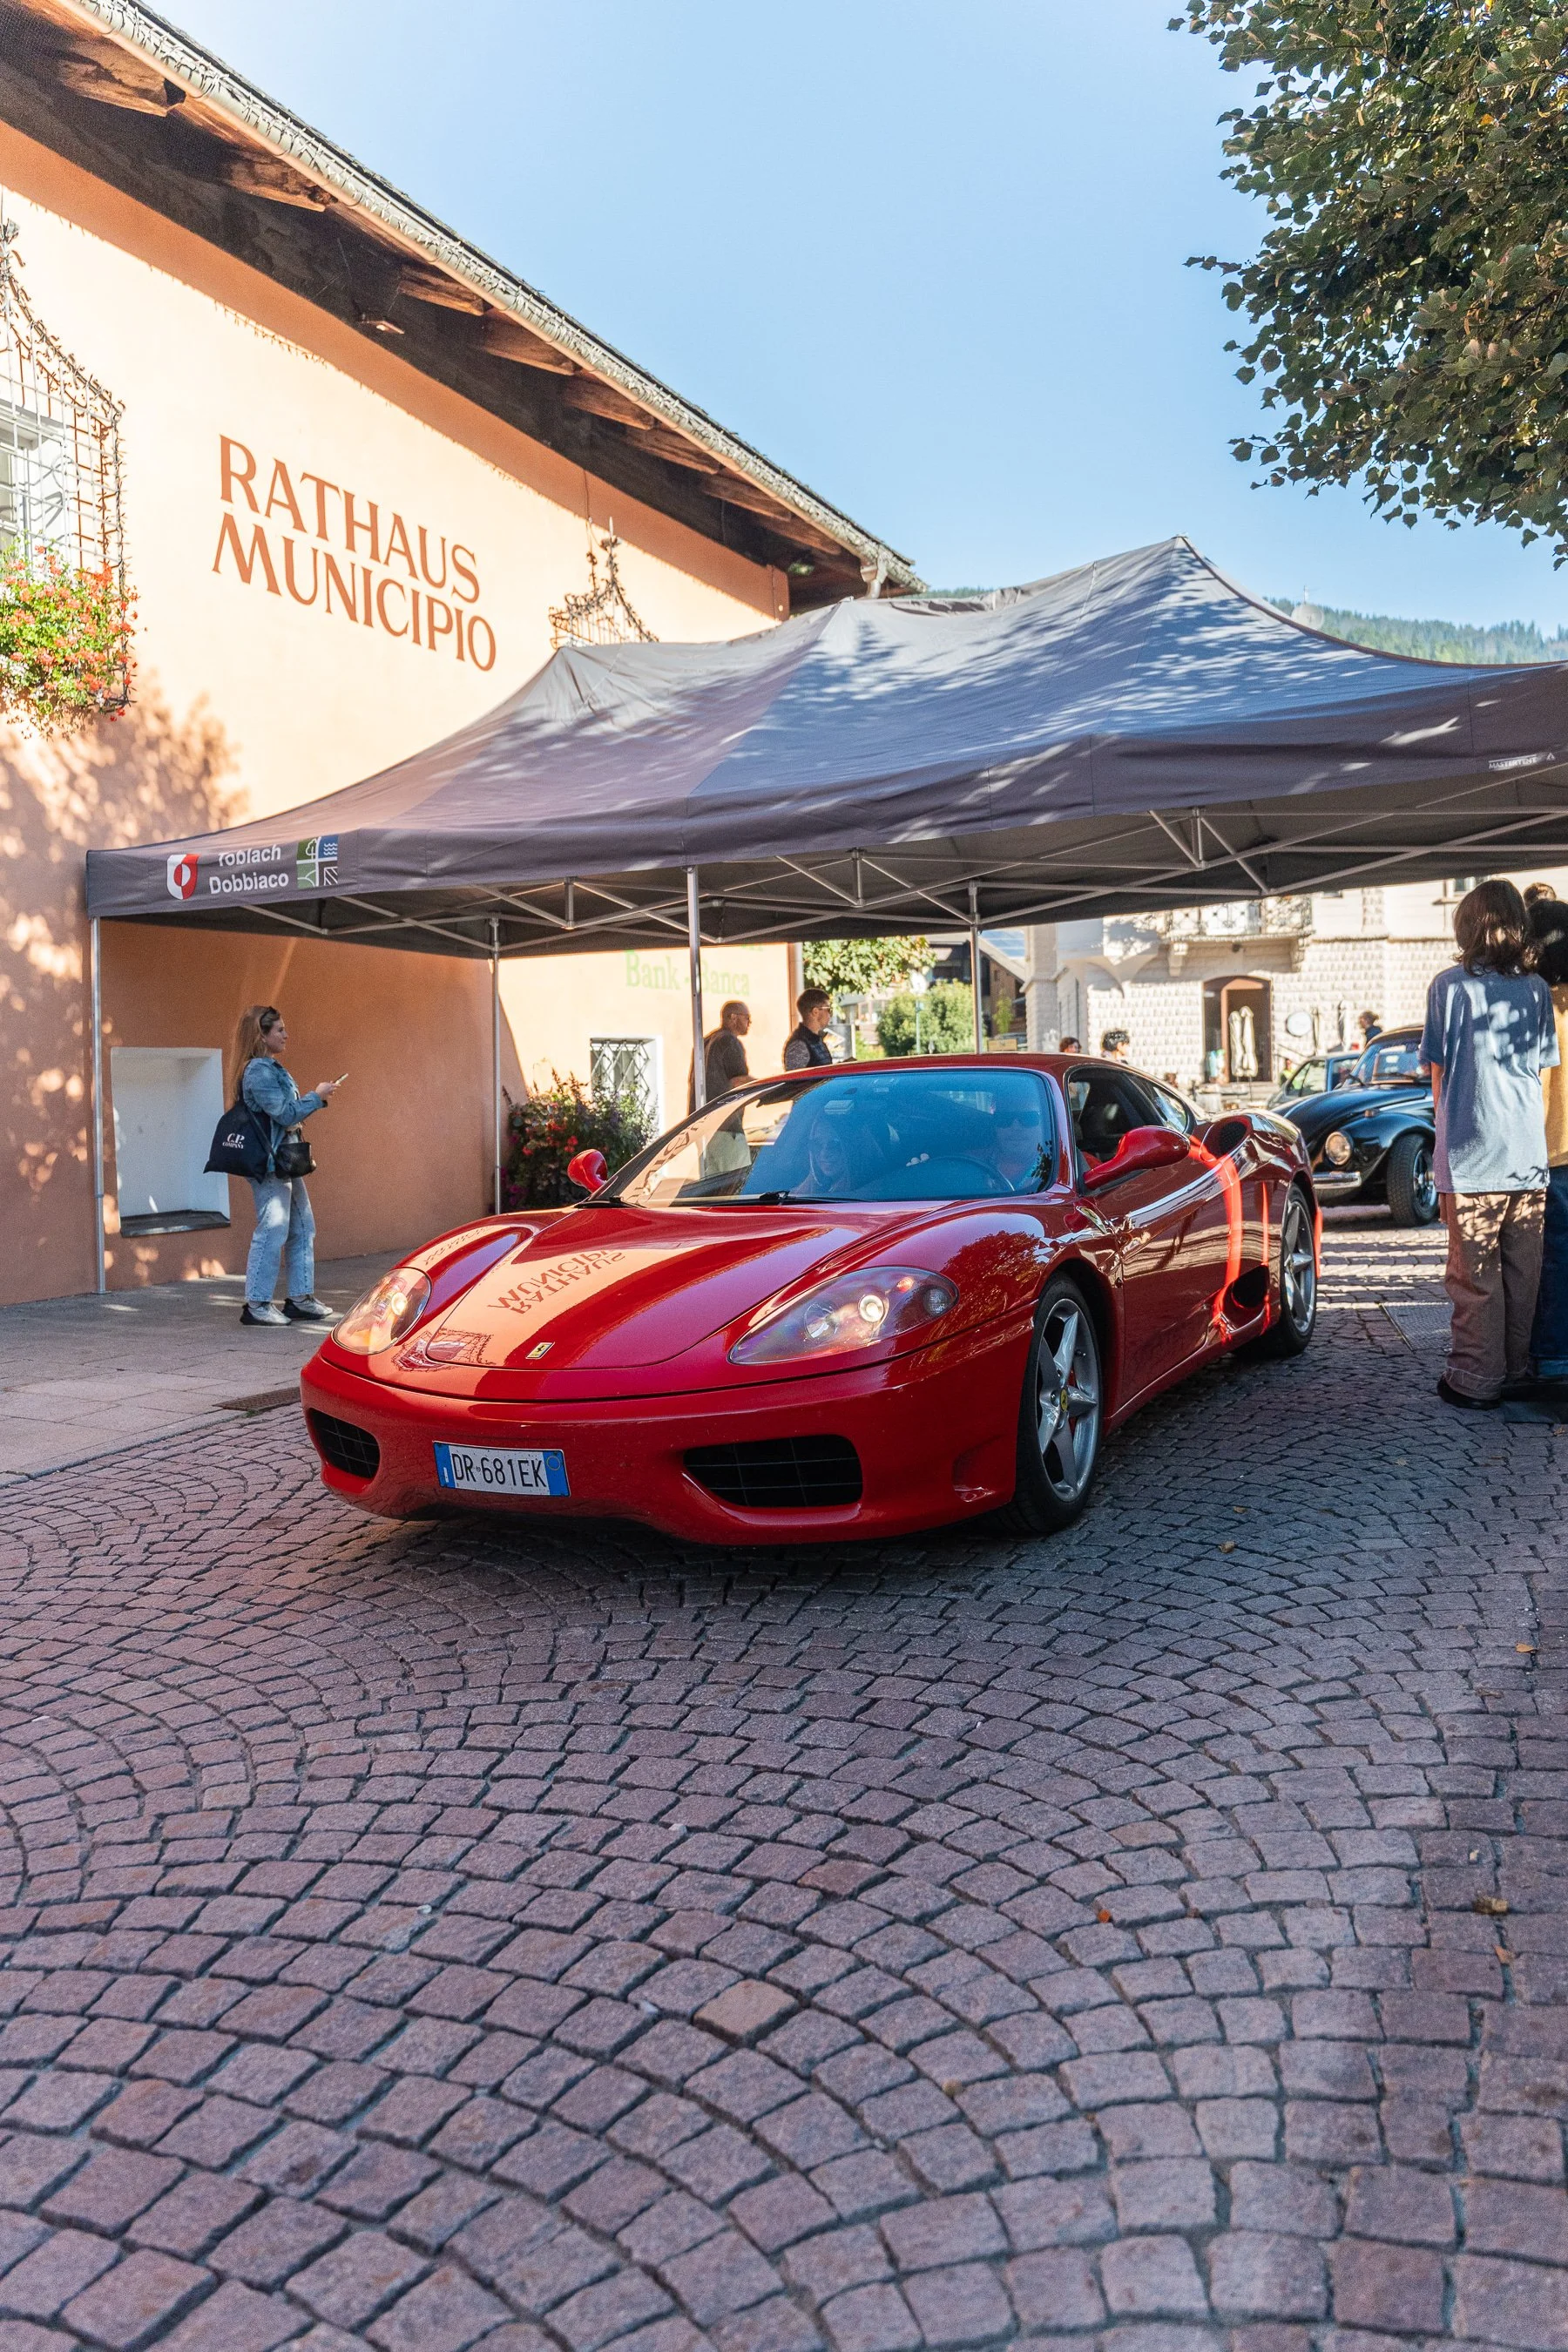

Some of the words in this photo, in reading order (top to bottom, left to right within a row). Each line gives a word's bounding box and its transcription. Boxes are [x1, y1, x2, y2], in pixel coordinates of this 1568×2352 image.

[220, 434, 480, 604] RATHAUS
[212, 511, 497, 672] MUNICIPIO
[218, 844, 281, 867] Toblach
[209, 871, 289, 895] Dobbiaco
[625, 951, 680, 990] Bank
